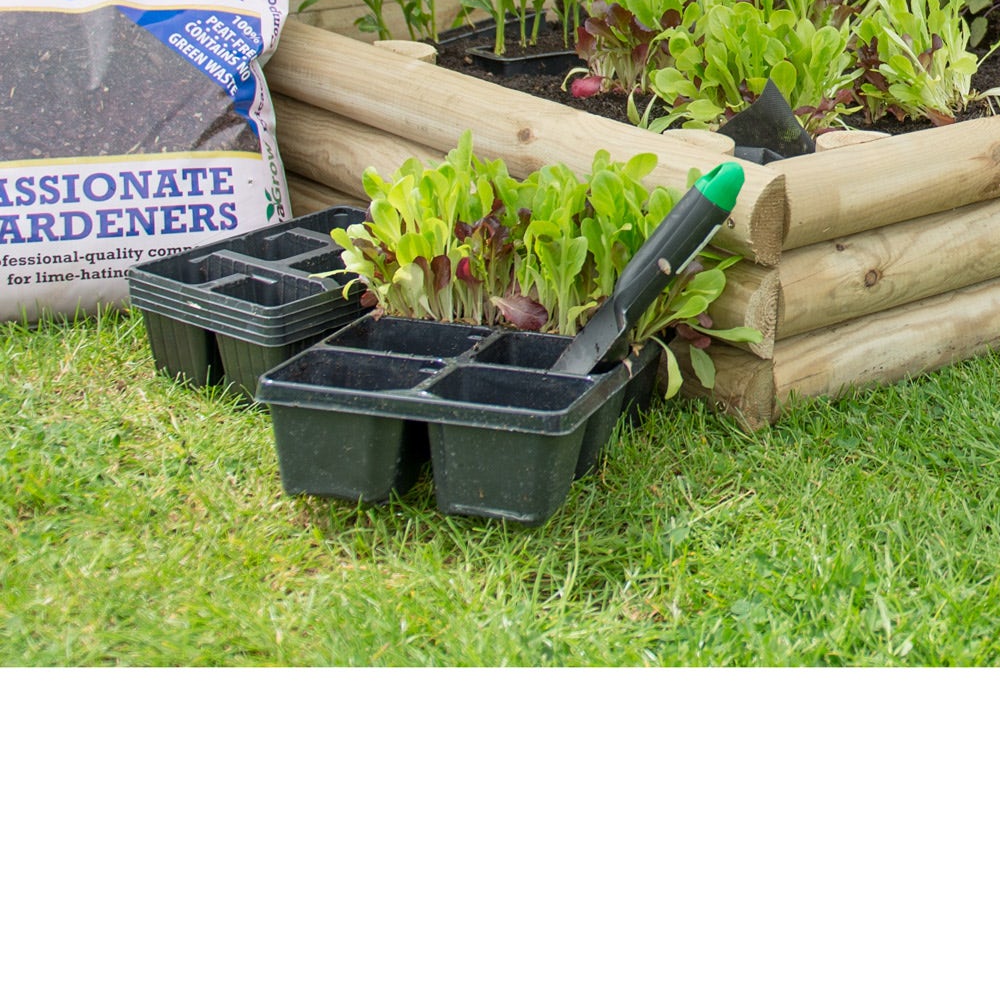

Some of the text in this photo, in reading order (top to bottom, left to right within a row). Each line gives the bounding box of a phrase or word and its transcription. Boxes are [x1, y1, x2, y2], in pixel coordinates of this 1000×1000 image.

[185, 22, 250, 81] CONTAINS NO
[206, 15, 257, 59] PEAT-FRE
[232, 15, 260, 44] 100%
[169, 33, 239, 96] GREEN WASTE
[7, 273, 31, 285] for
